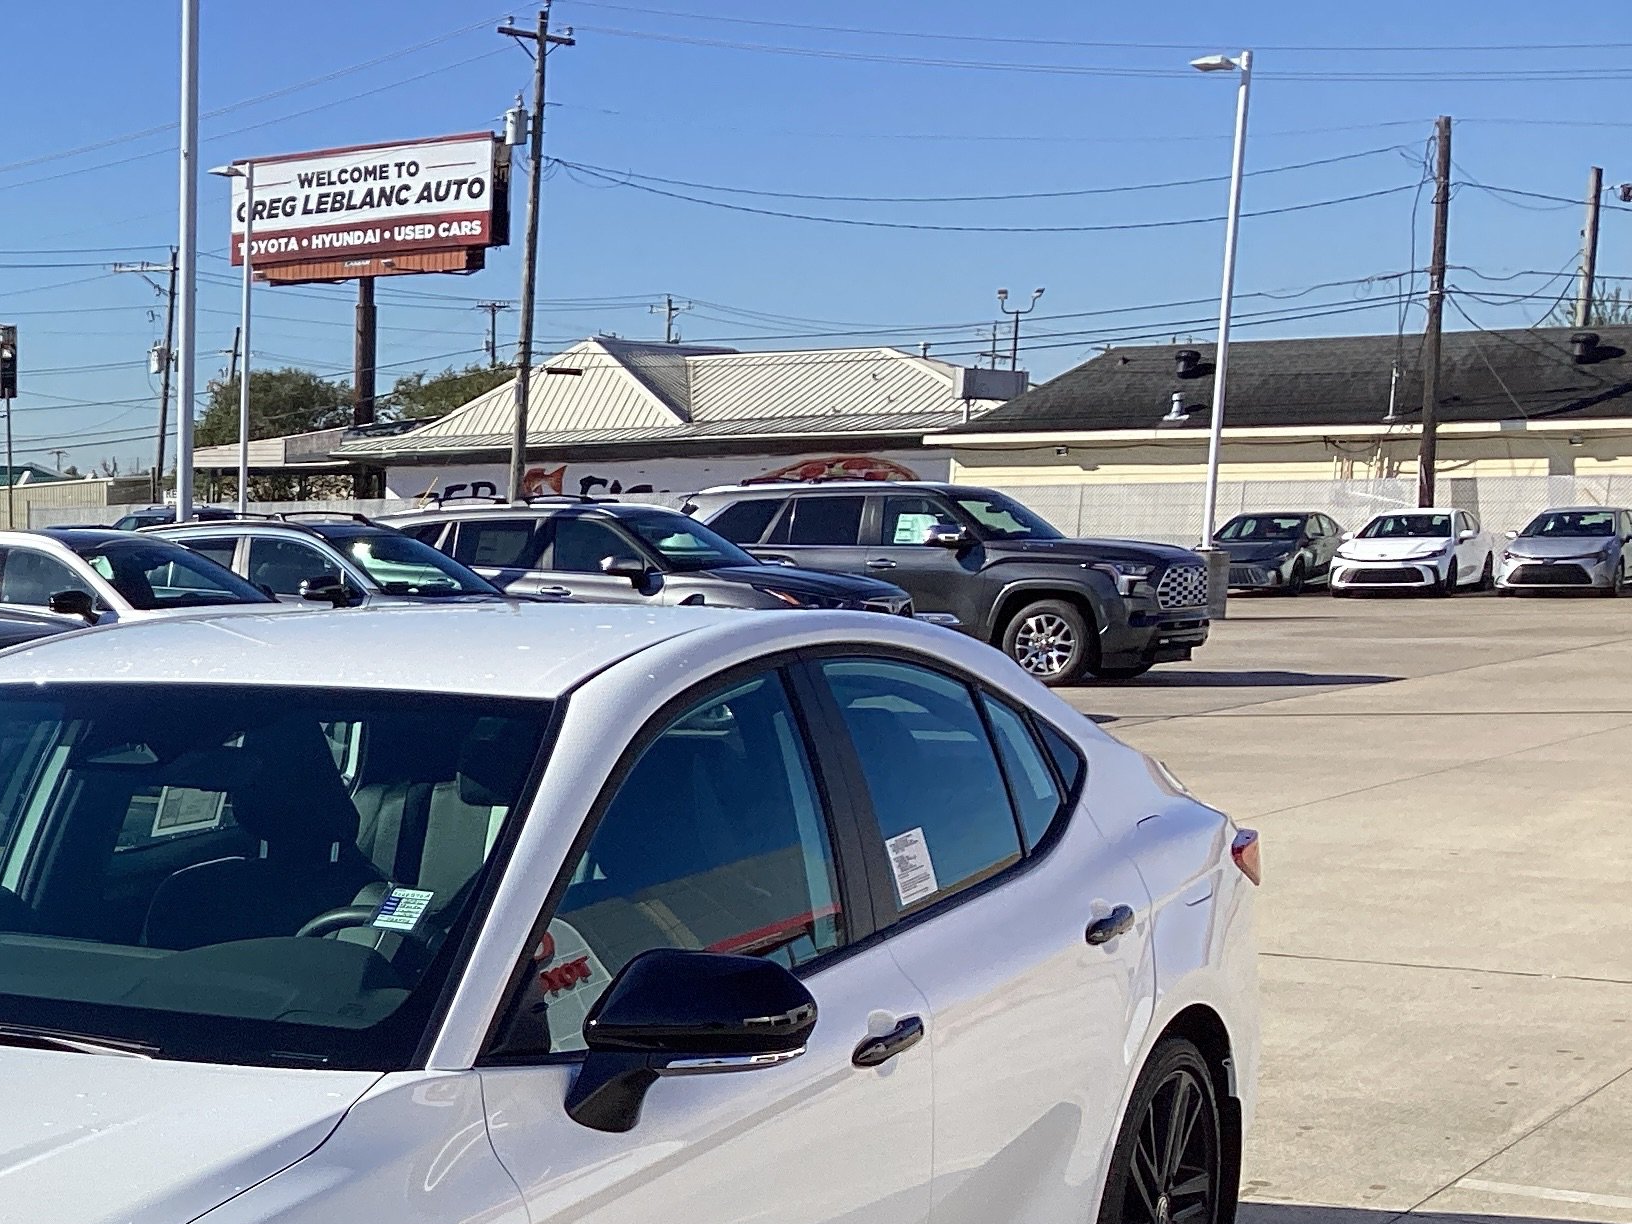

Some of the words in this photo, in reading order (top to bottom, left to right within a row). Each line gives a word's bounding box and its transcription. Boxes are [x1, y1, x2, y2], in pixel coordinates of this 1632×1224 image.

[297, 164, 390, 189] WELCOME
[394, 160, 419, 178] TO
[301, 184, 412, 215] LEBLANC
[414, 177, 485, 204] AUTO
[311, 229, 381, 249] HYUNDAI
[393, 224, 435, 241] USED
[438, 220, 482, 238] CARS
